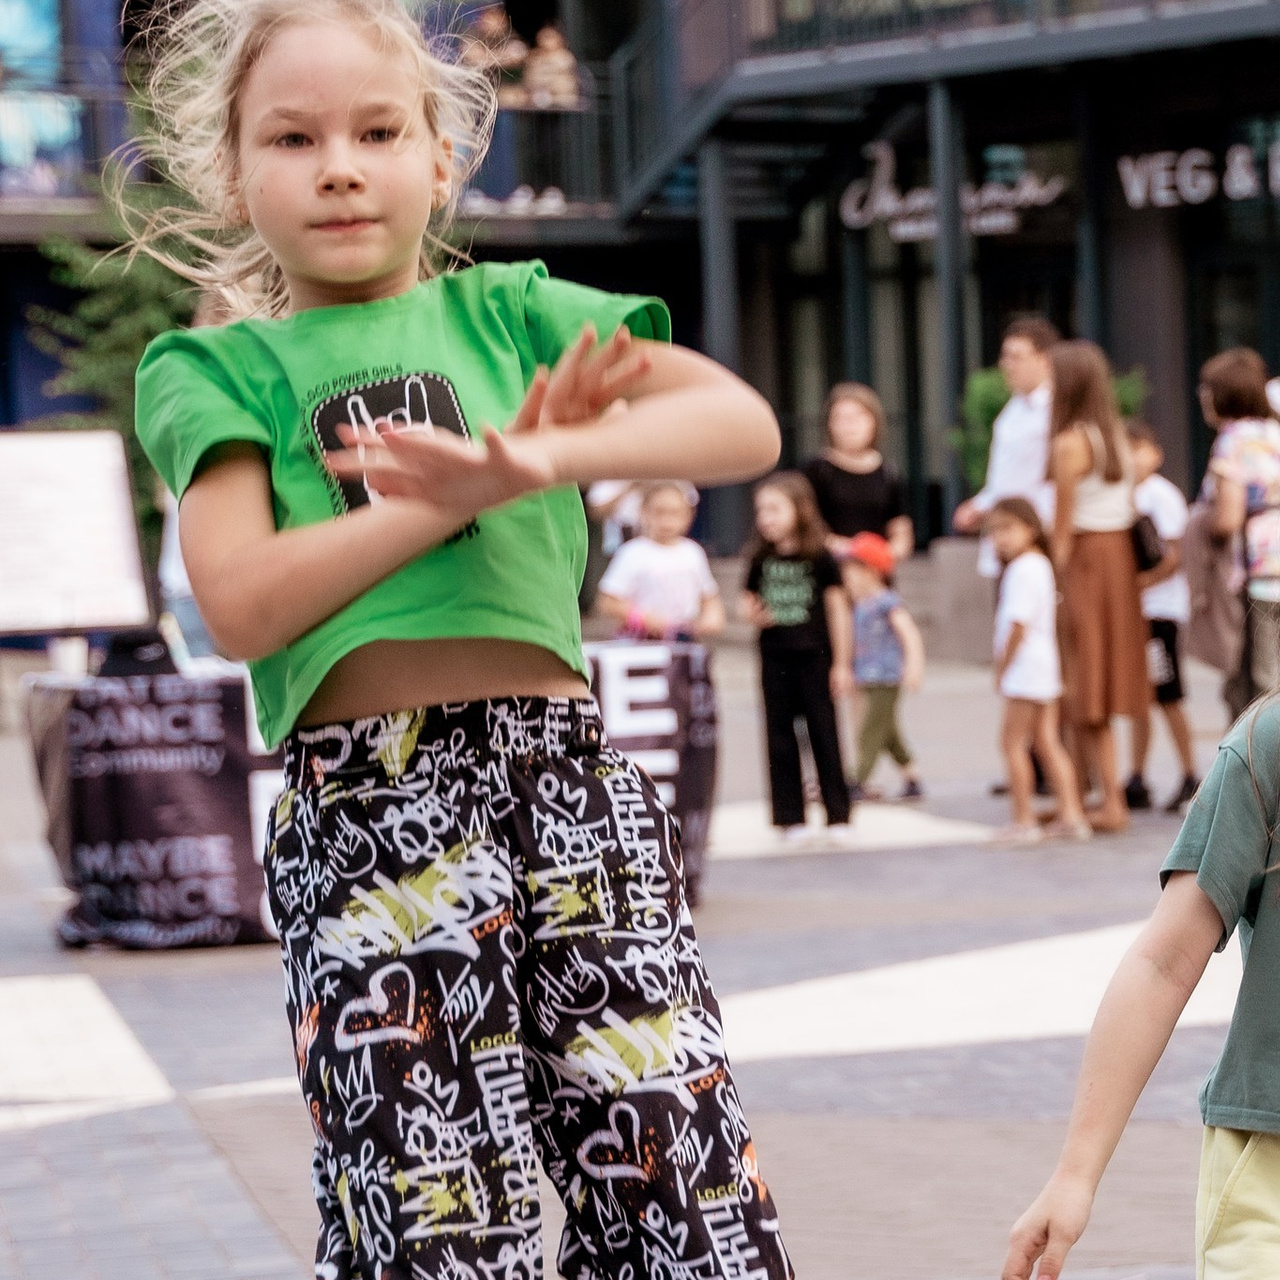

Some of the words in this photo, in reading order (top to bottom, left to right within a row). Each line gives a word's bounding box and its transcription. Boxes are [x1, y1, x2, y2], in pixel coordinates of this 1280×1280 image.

[1116, 148, 1218, 210] VEG
[1222, 143, 1260, 201] &
[331, 368, 369, 391] POWER
[66, 703, 226, 748] DANCE
[74, 834, 238, 882] MAYBE
